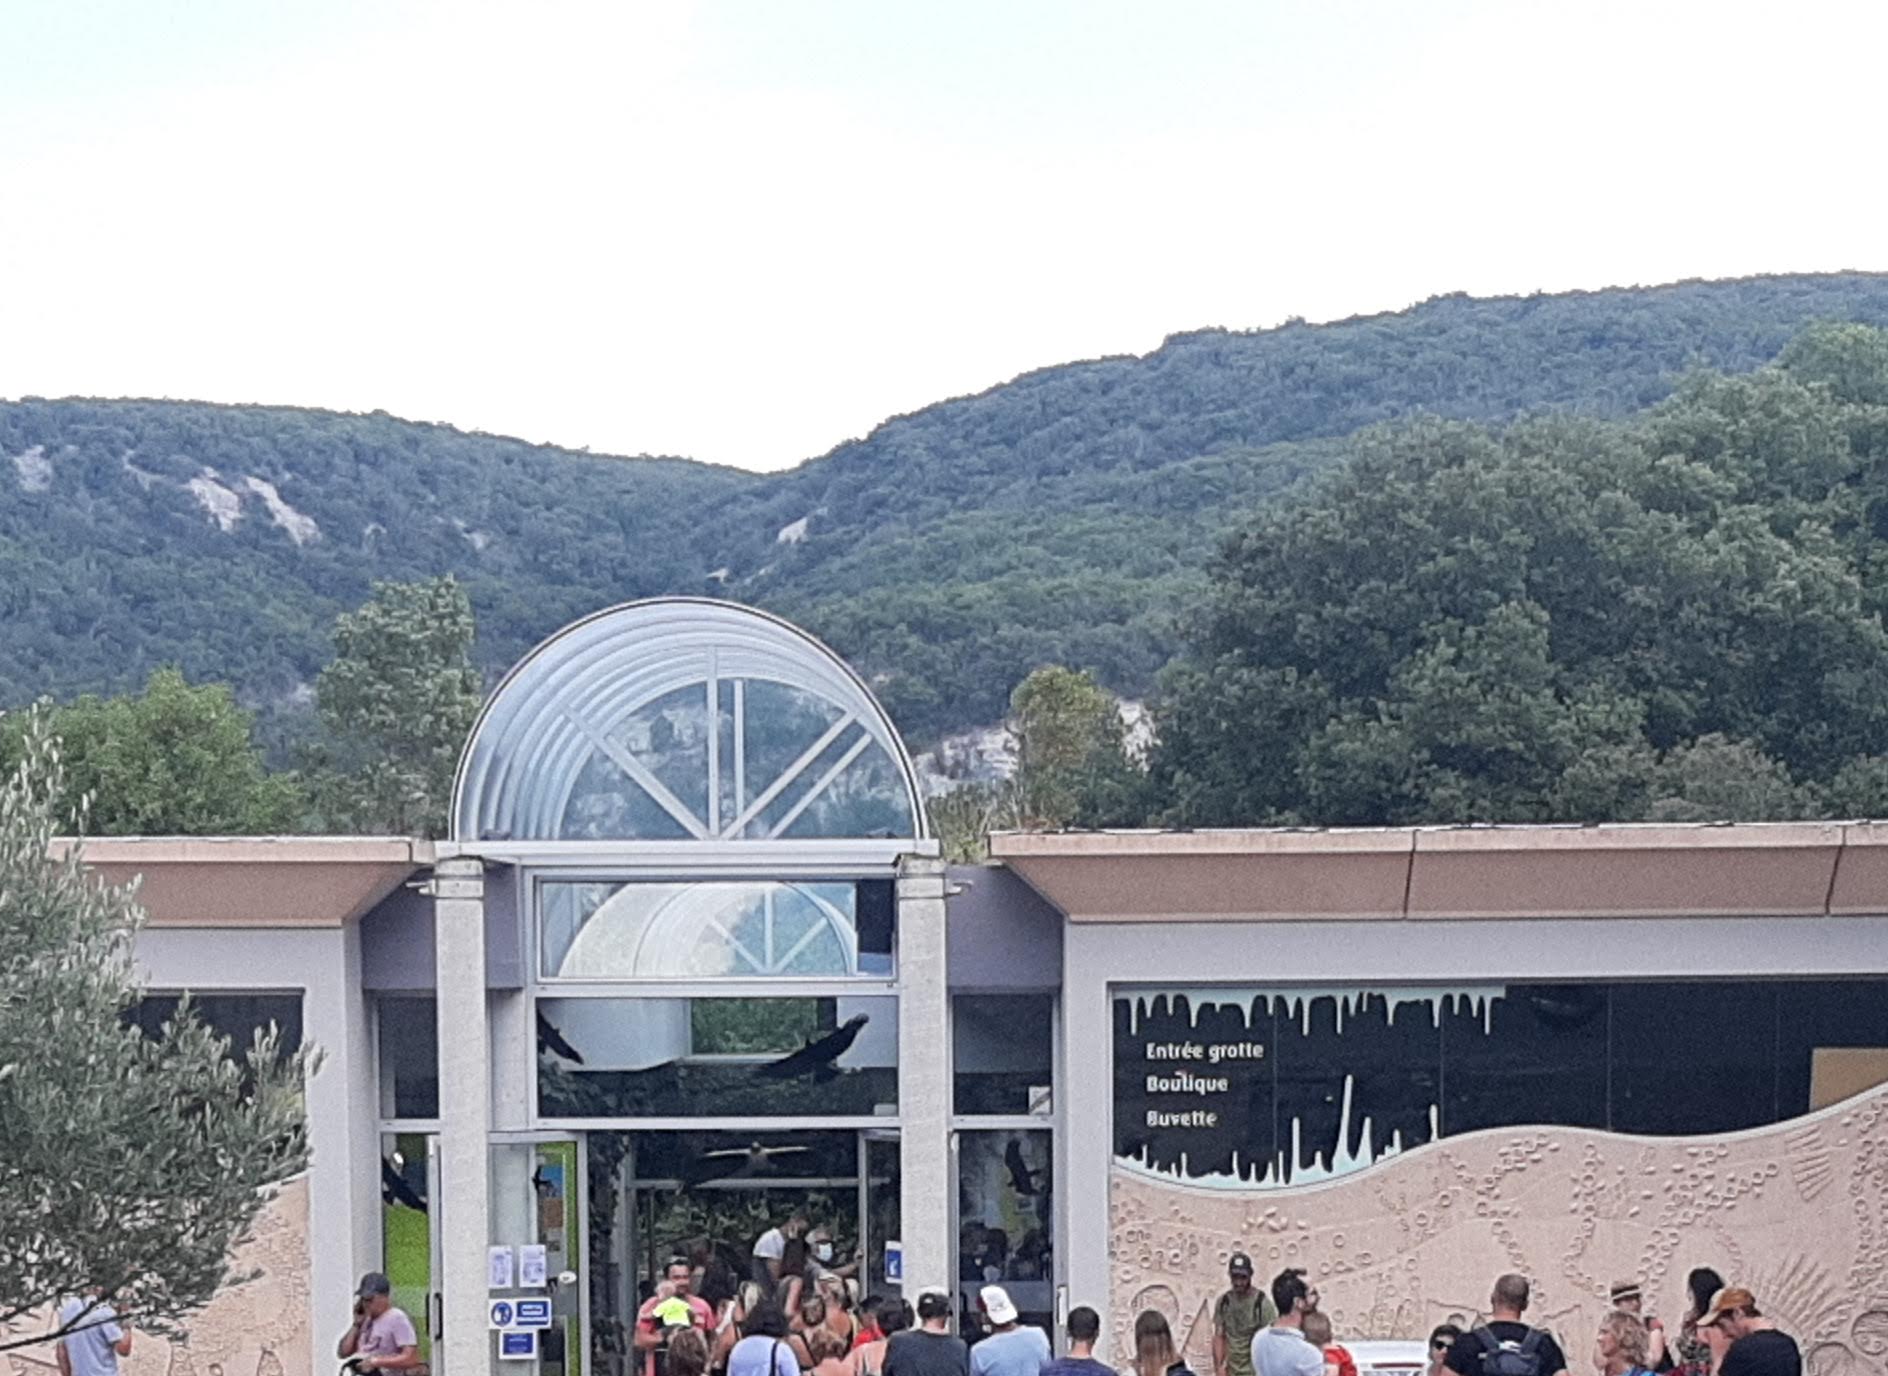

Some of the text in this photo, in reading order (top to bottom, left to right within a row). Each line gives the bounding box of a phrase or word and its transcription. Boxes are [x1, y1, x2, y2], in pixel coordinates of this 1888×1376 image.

[1146, 1041, 1264, 1063] Entrée grotte
[1146, 1073, 1229, 1095] Boutique
[1146, 1110, 1218, 1127] Buvette
